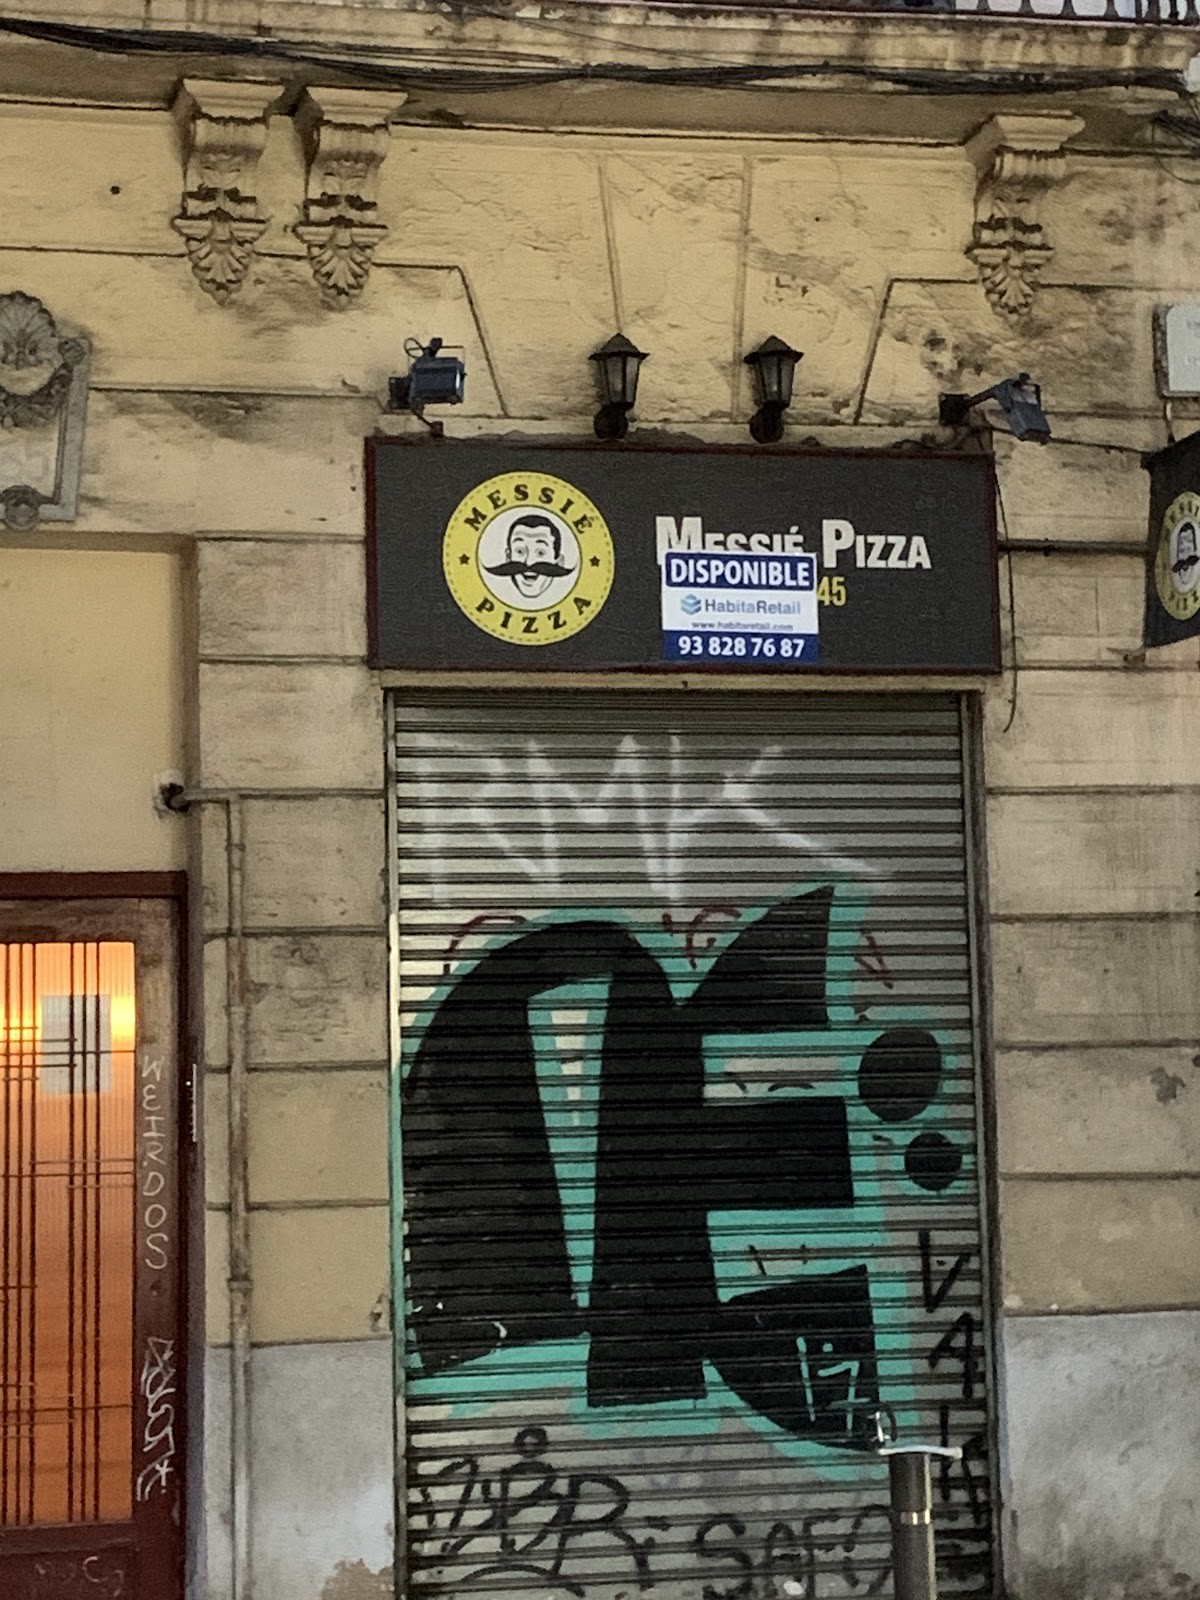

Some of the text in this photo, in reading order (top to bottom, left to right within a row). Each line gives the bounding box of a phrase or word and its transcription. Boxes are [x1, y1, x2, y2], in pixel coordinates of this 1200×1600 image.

[463, 483, 596, 535] MESSIÉ
[669, 557, 811, 588] DISPONIBLE
[475, 595, 592, 634] PIZZA
[704, 598, 801, 615] HabitaRetail
[677, 635, 806, 659] 93 828 76 87
